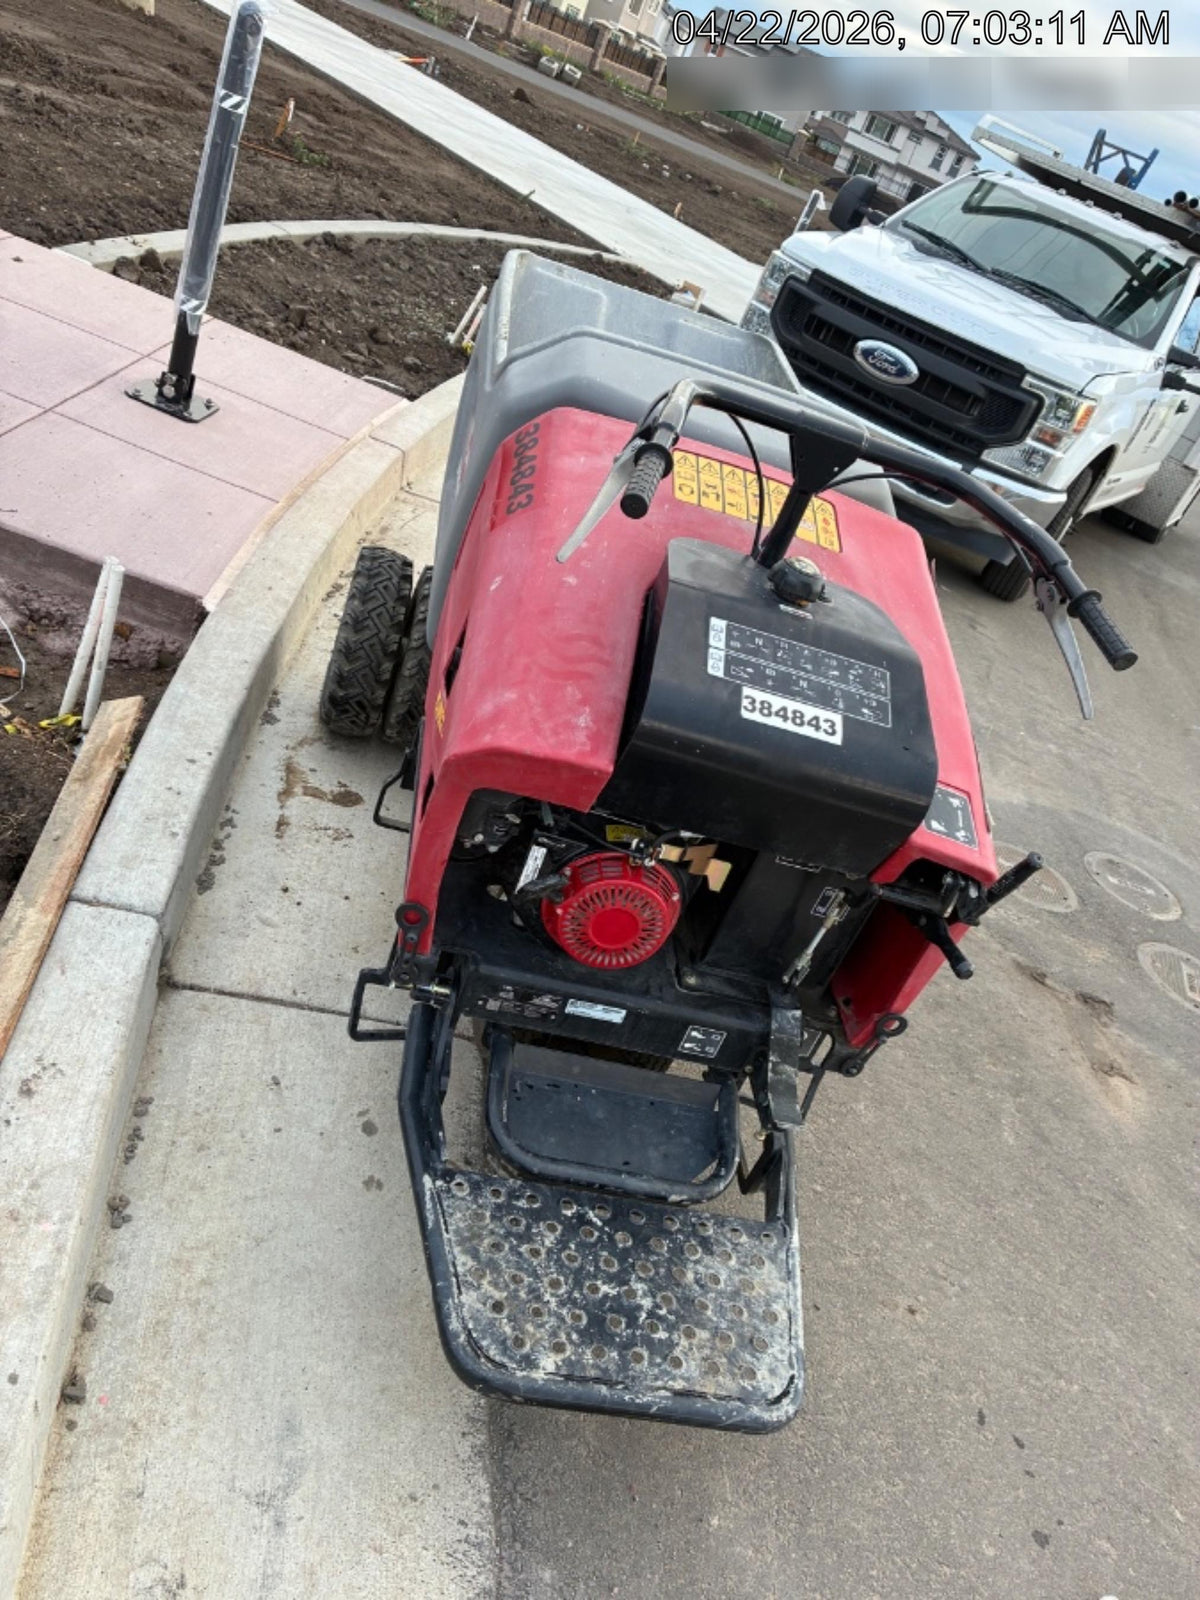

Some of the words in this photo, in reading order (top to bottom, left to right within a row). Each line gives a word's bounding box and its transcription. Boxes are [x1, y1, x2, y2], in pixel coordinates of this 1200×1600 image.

[868, 350, 901, 374] Ford
[506, 422, 540, 515] 384843
[742, 694, 837, 737] 384843
